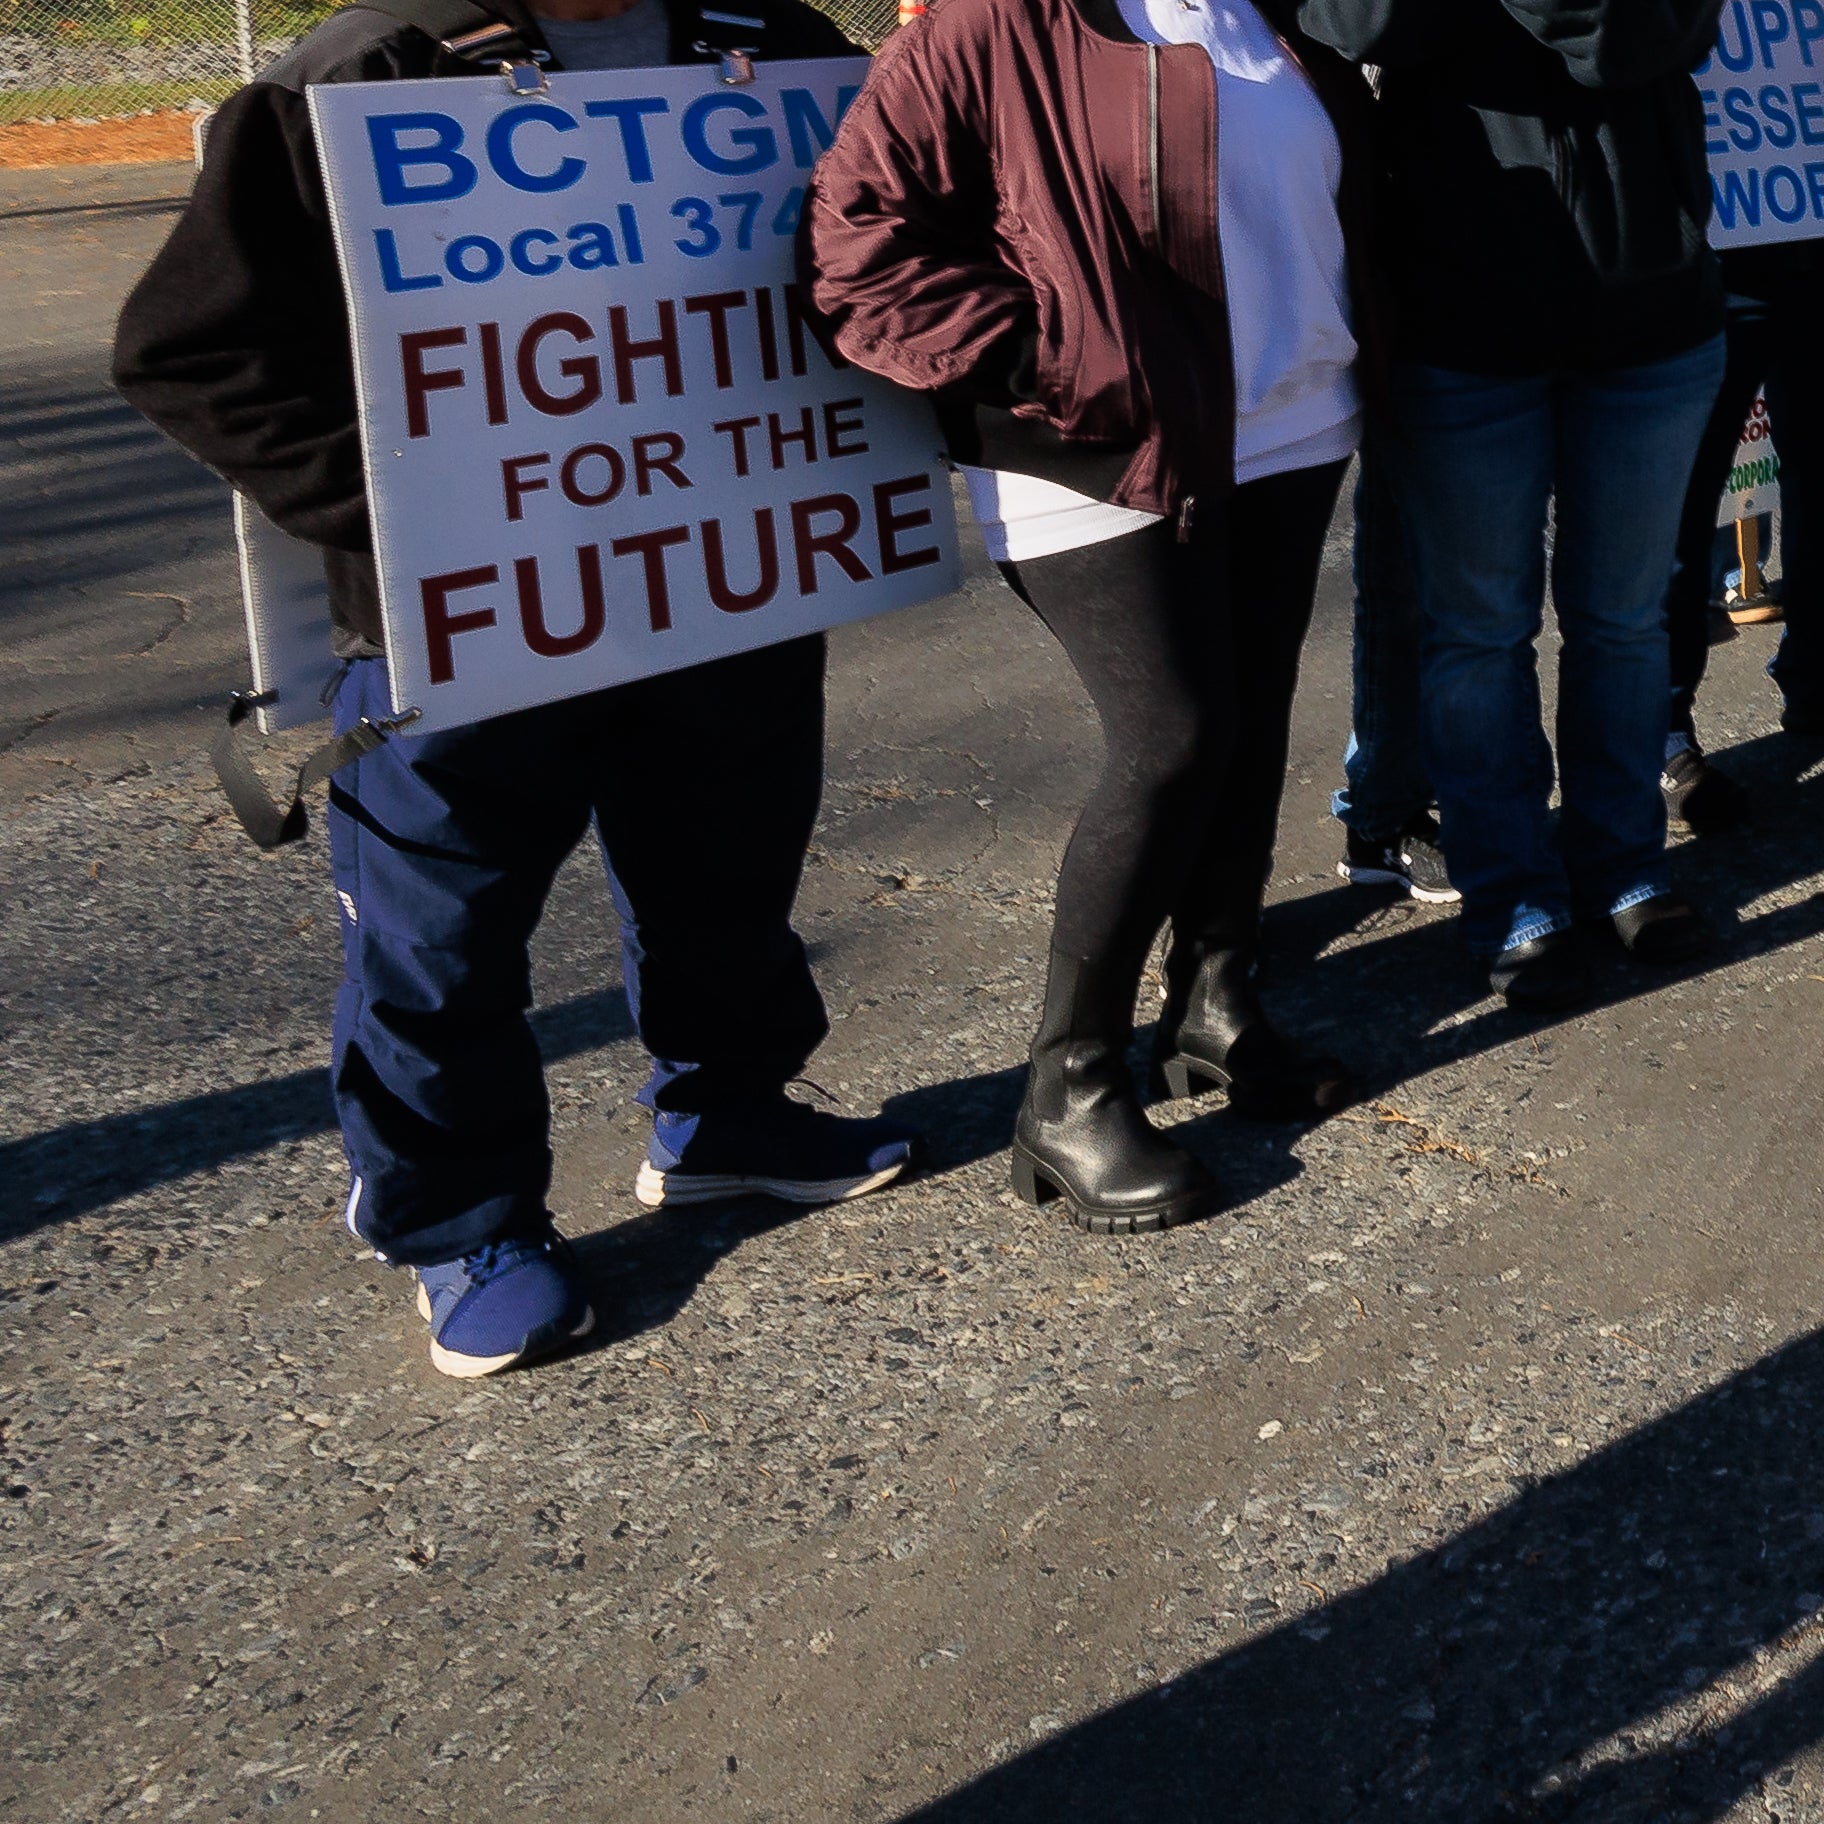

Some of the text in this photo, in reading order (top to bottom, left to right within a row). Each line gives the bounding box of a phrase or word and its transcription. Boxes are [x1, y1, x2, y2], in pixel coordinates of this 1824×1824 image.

[372, 204, 644, 294] Local
[400, 282, 845, 440] FIGHTIN
[502, 398, 869, 523] FOR THE
[420, 473, 941, 685] FUTURE
